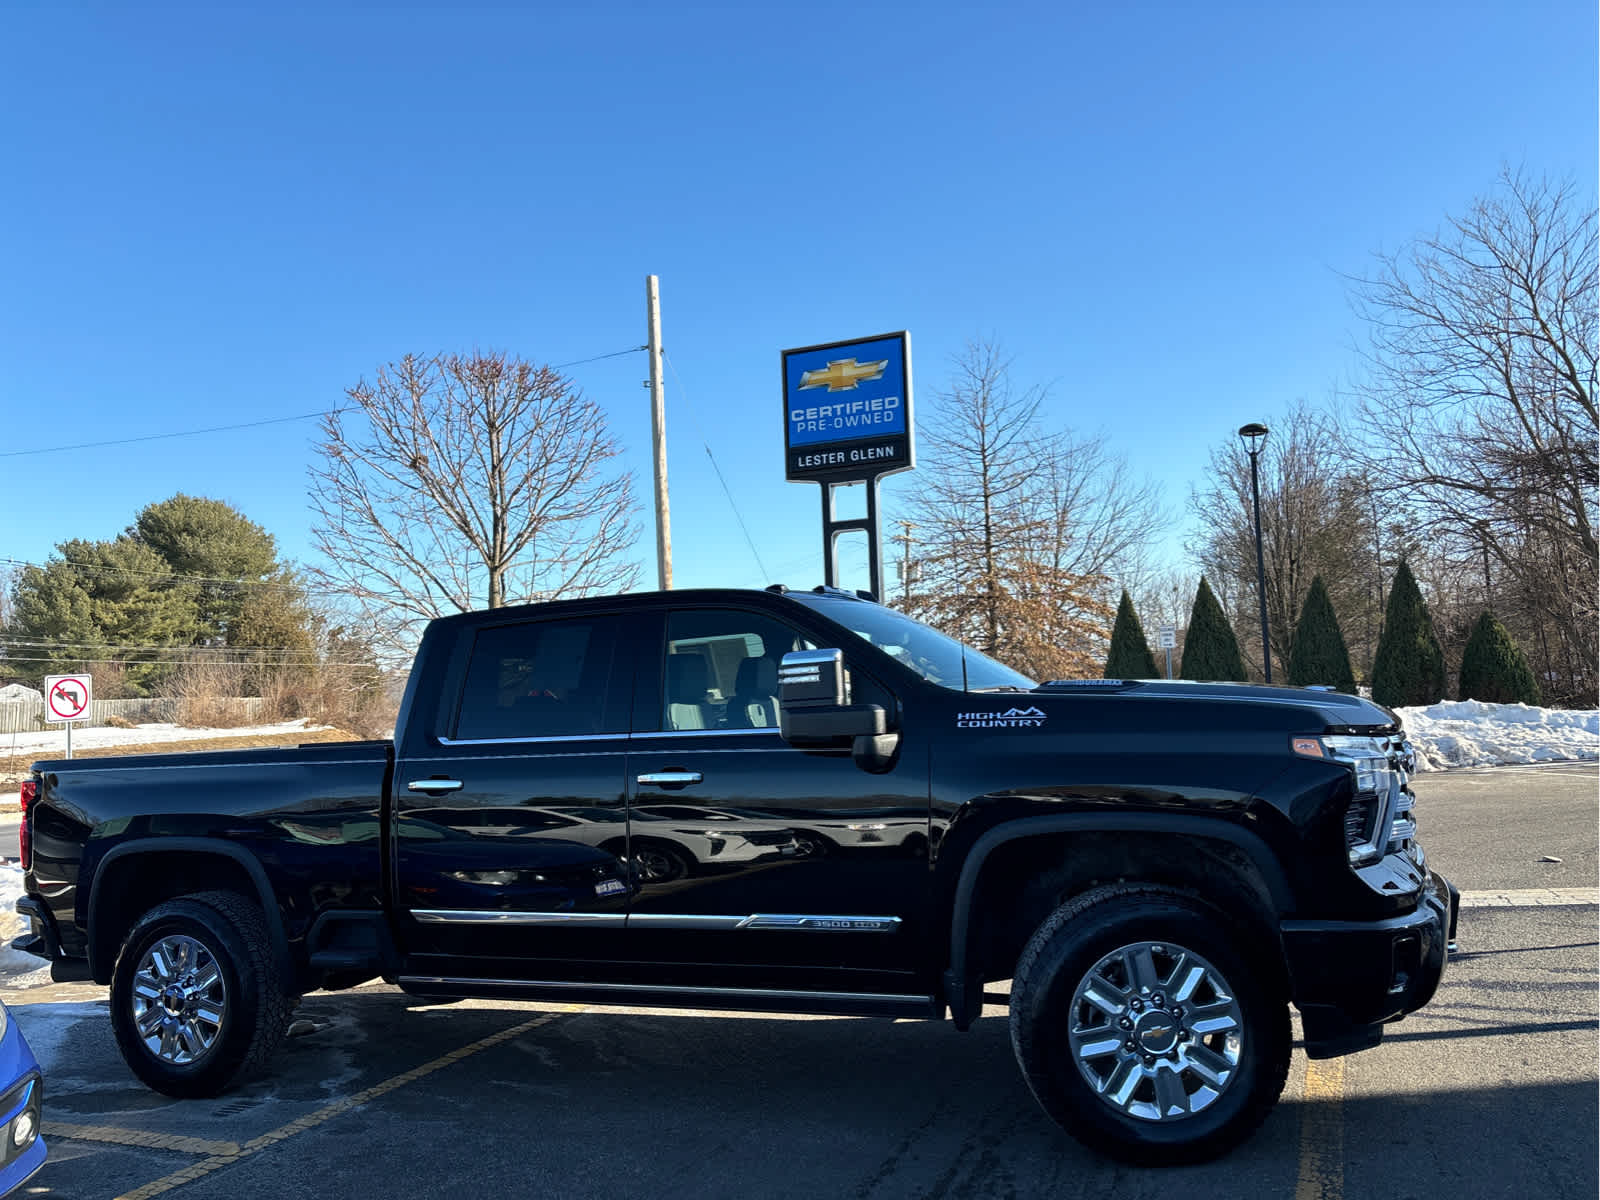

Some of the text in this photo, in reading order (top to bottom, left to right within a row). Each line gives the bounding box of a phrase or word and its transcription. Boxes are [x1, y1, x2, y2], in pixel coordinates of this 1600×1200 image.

[791, 396, 900, 422] CERTIFIED
[797, 410, 895, 433] PRE-OWNED
[798, 445, 895, 467] LESTER GLENN
[956, 719, 1045, 728] COUNTRY
[957, 712, 1002, 720] HIGH
[812, 920, 850, 928] 3500
